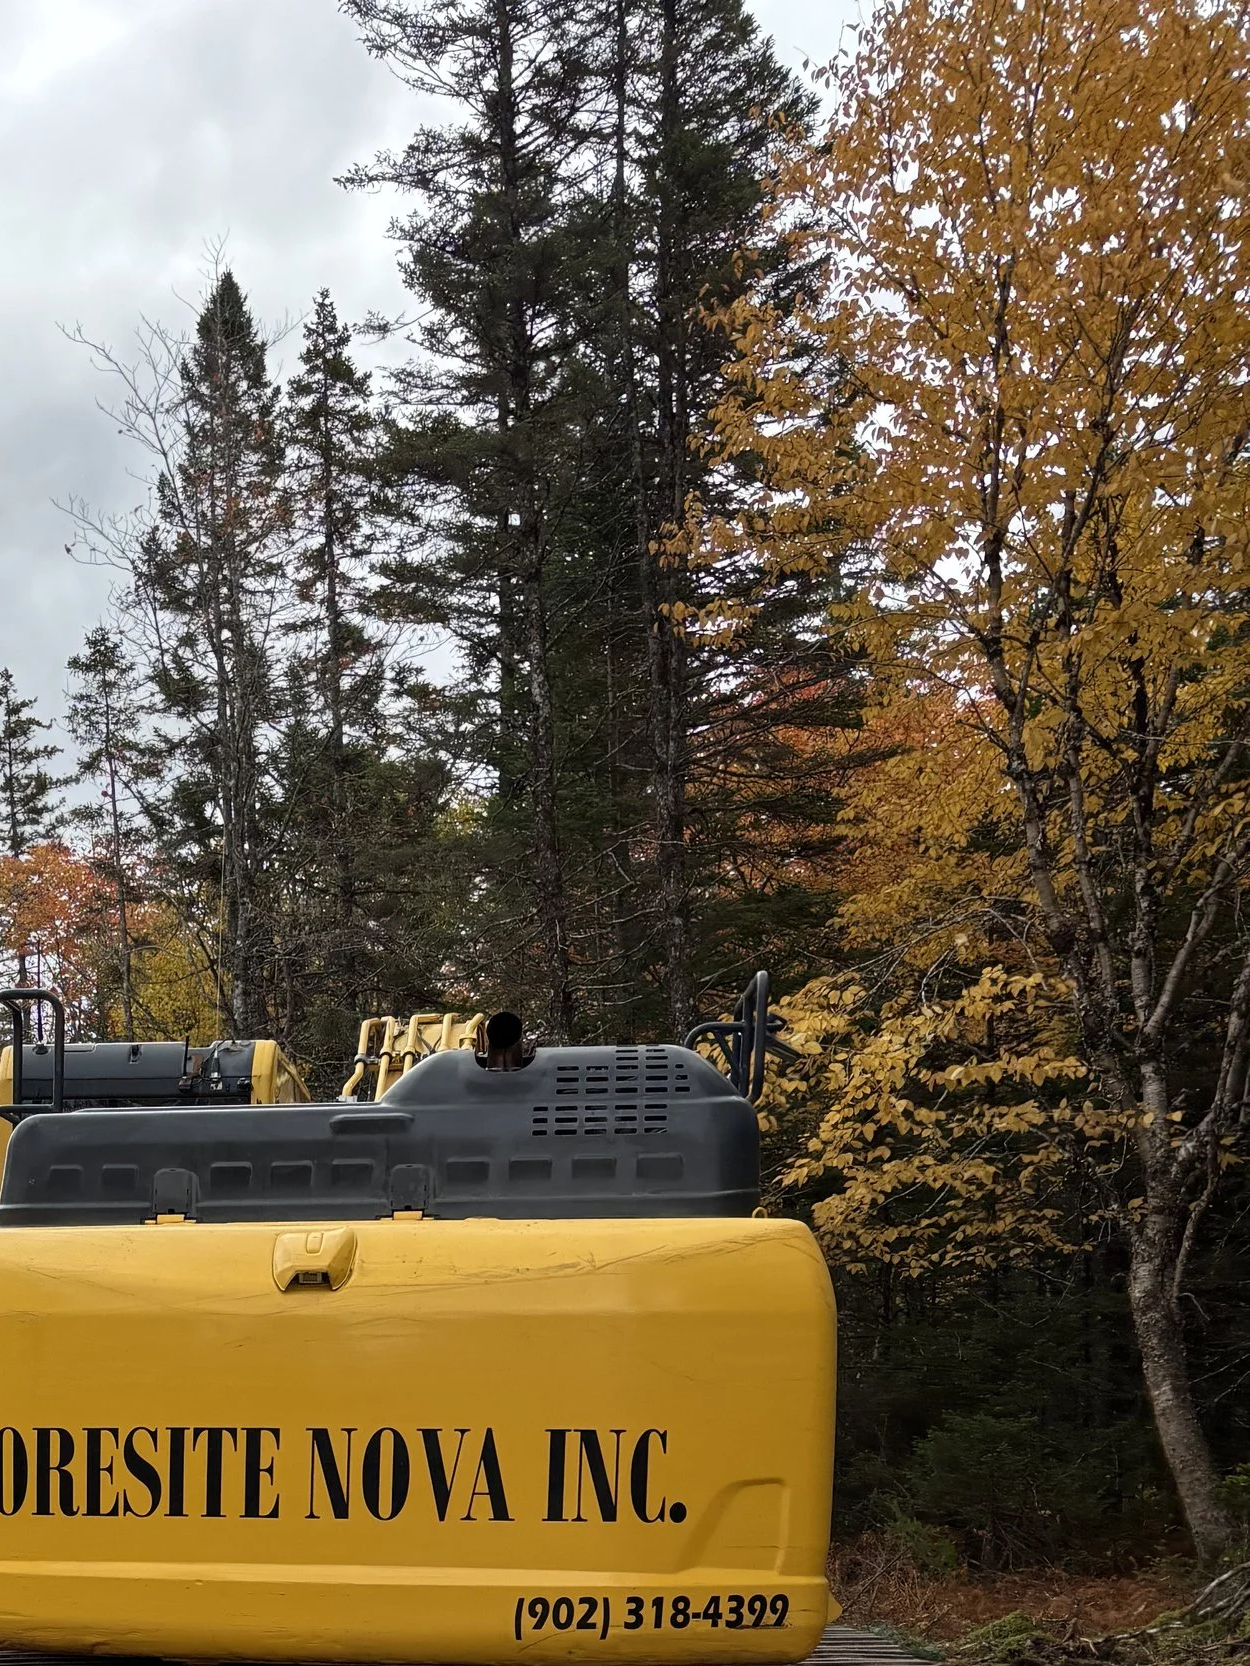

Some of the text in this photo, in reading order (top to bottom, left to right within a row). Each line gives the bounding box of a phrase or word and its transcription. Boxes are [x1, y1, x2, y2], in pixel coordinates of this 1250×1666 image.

[304, 1427, 515, 1522] NOVA
[541, 1428, 688, 1524] INC.
[514, 1593, 790, 1640] (902) 318-4399
